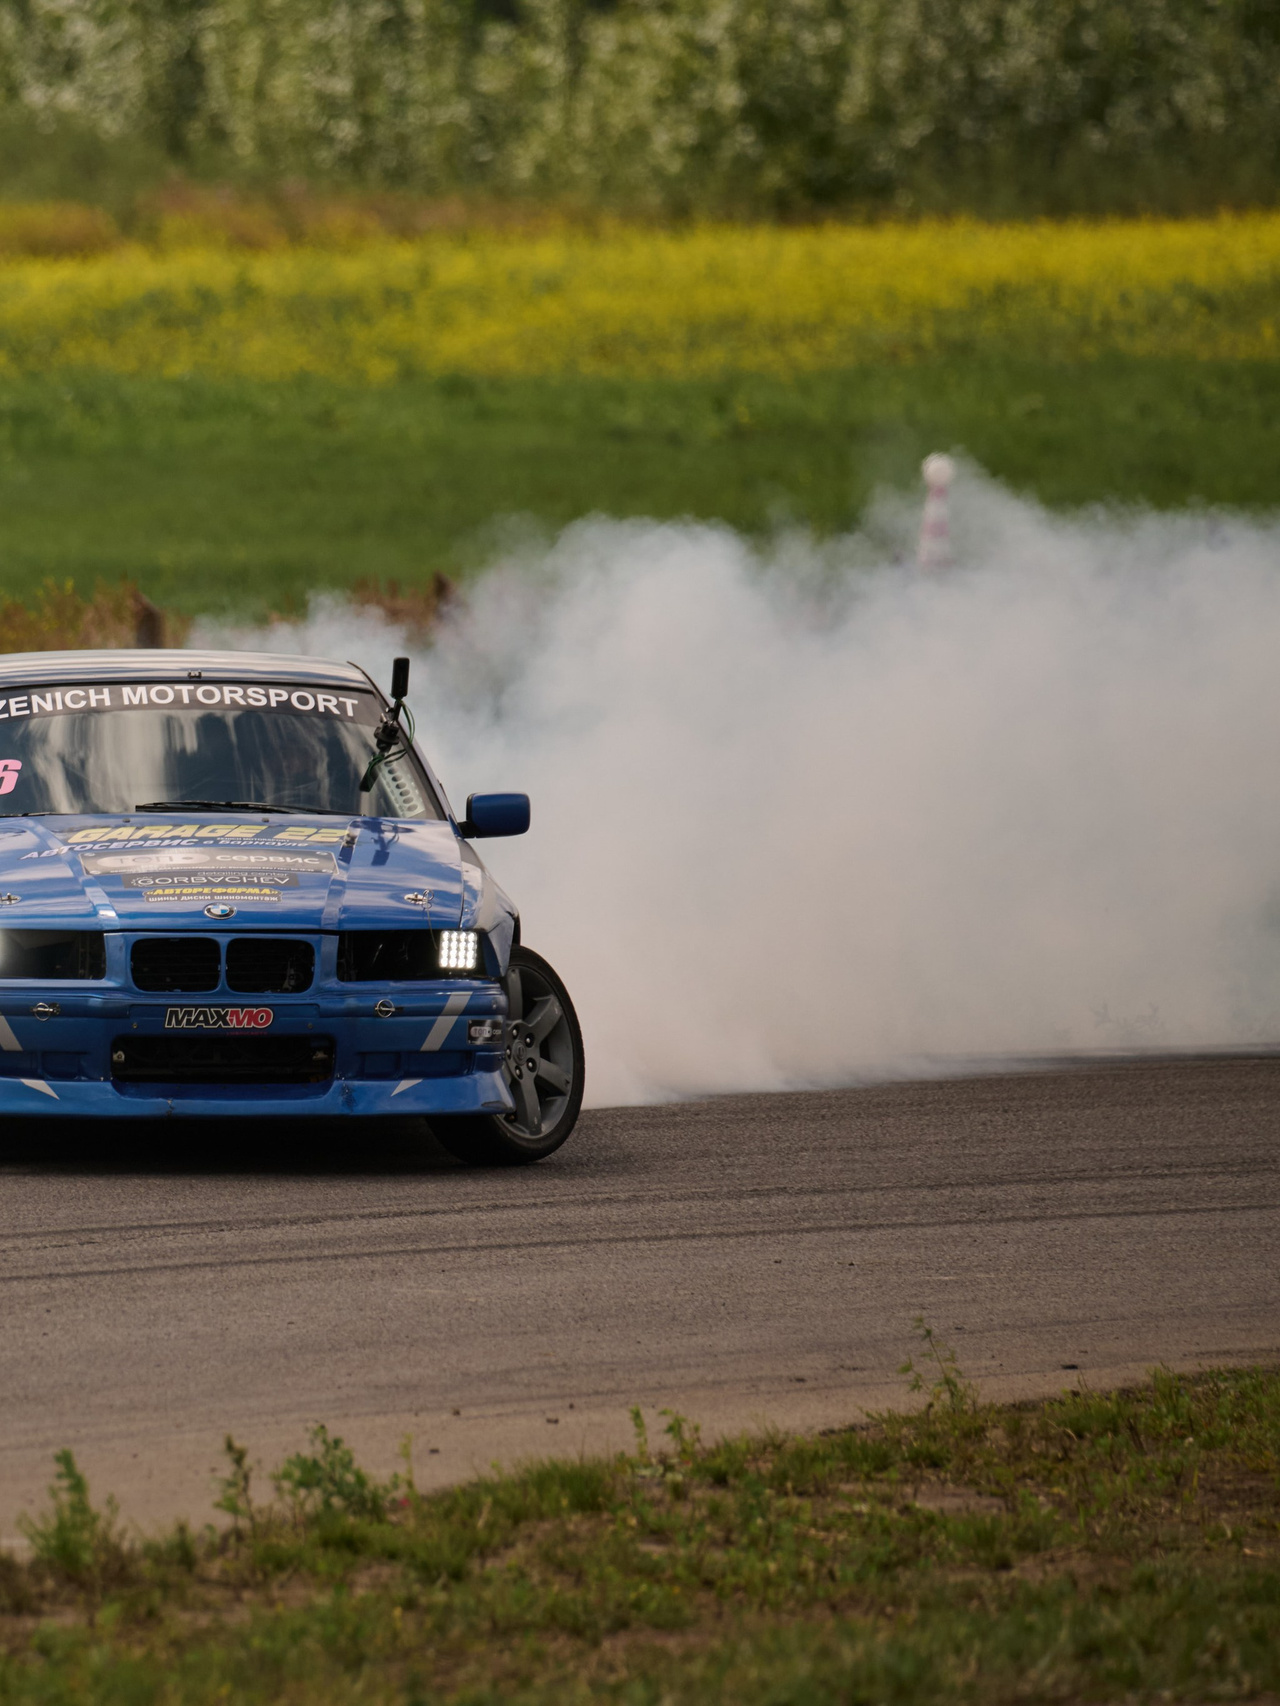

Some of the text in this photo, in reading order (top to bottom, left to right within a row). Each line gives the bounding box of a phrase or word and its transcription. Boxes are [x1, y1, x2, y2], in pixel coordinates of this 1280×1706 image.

[122, 685, 359, 717] MOTORSPORT
[68, 824, 347, 843] GARAGE 22
[20, 838, 199, 860] АВТОСЕРВИС
[165, 1008, 273, 1028] MAXMO
